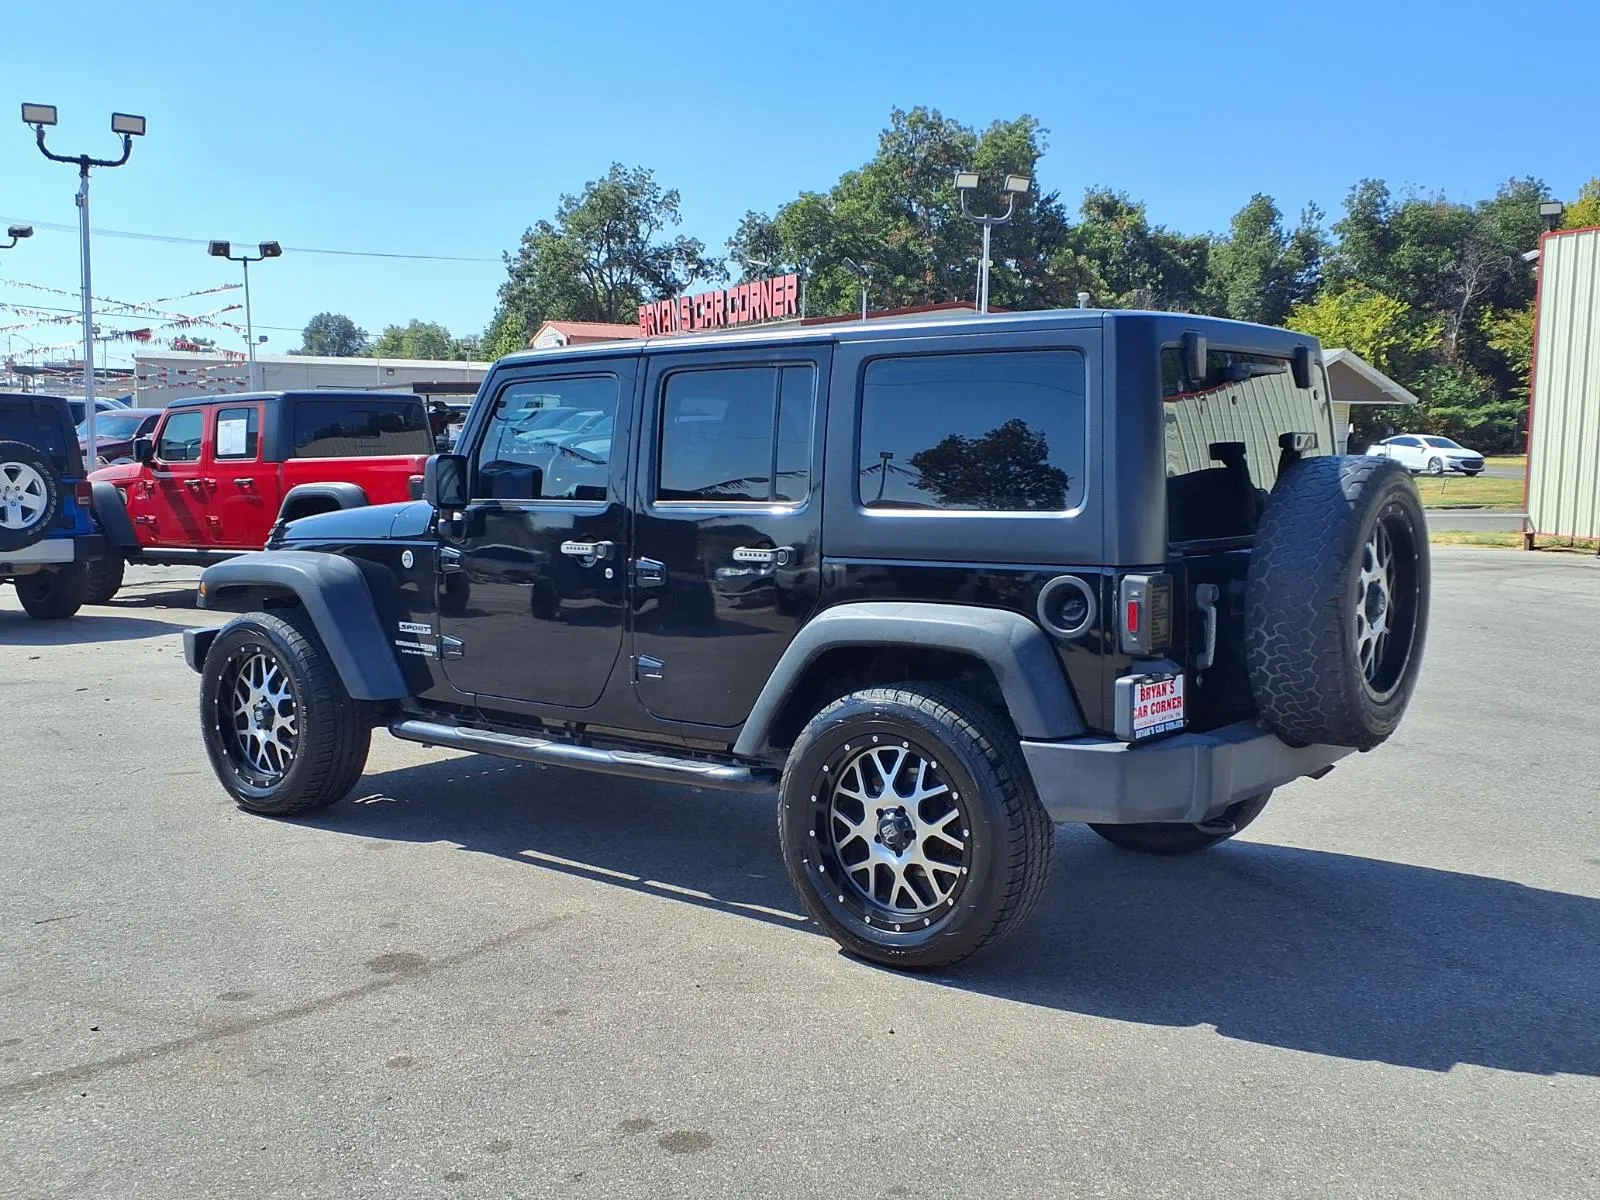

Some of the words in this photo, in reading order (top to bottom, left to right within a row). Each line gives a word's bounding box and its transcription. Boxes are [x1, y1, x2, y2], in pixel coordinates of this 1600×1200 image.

[694, 289, 724, 329] CAR
[728, 273, 798, 324] CORNER
[400, 623, 431, 633] SPORT
[1140, 680, 1175, 702] BRYAN'S
[1151, 696, 1182, 715] CORNER
